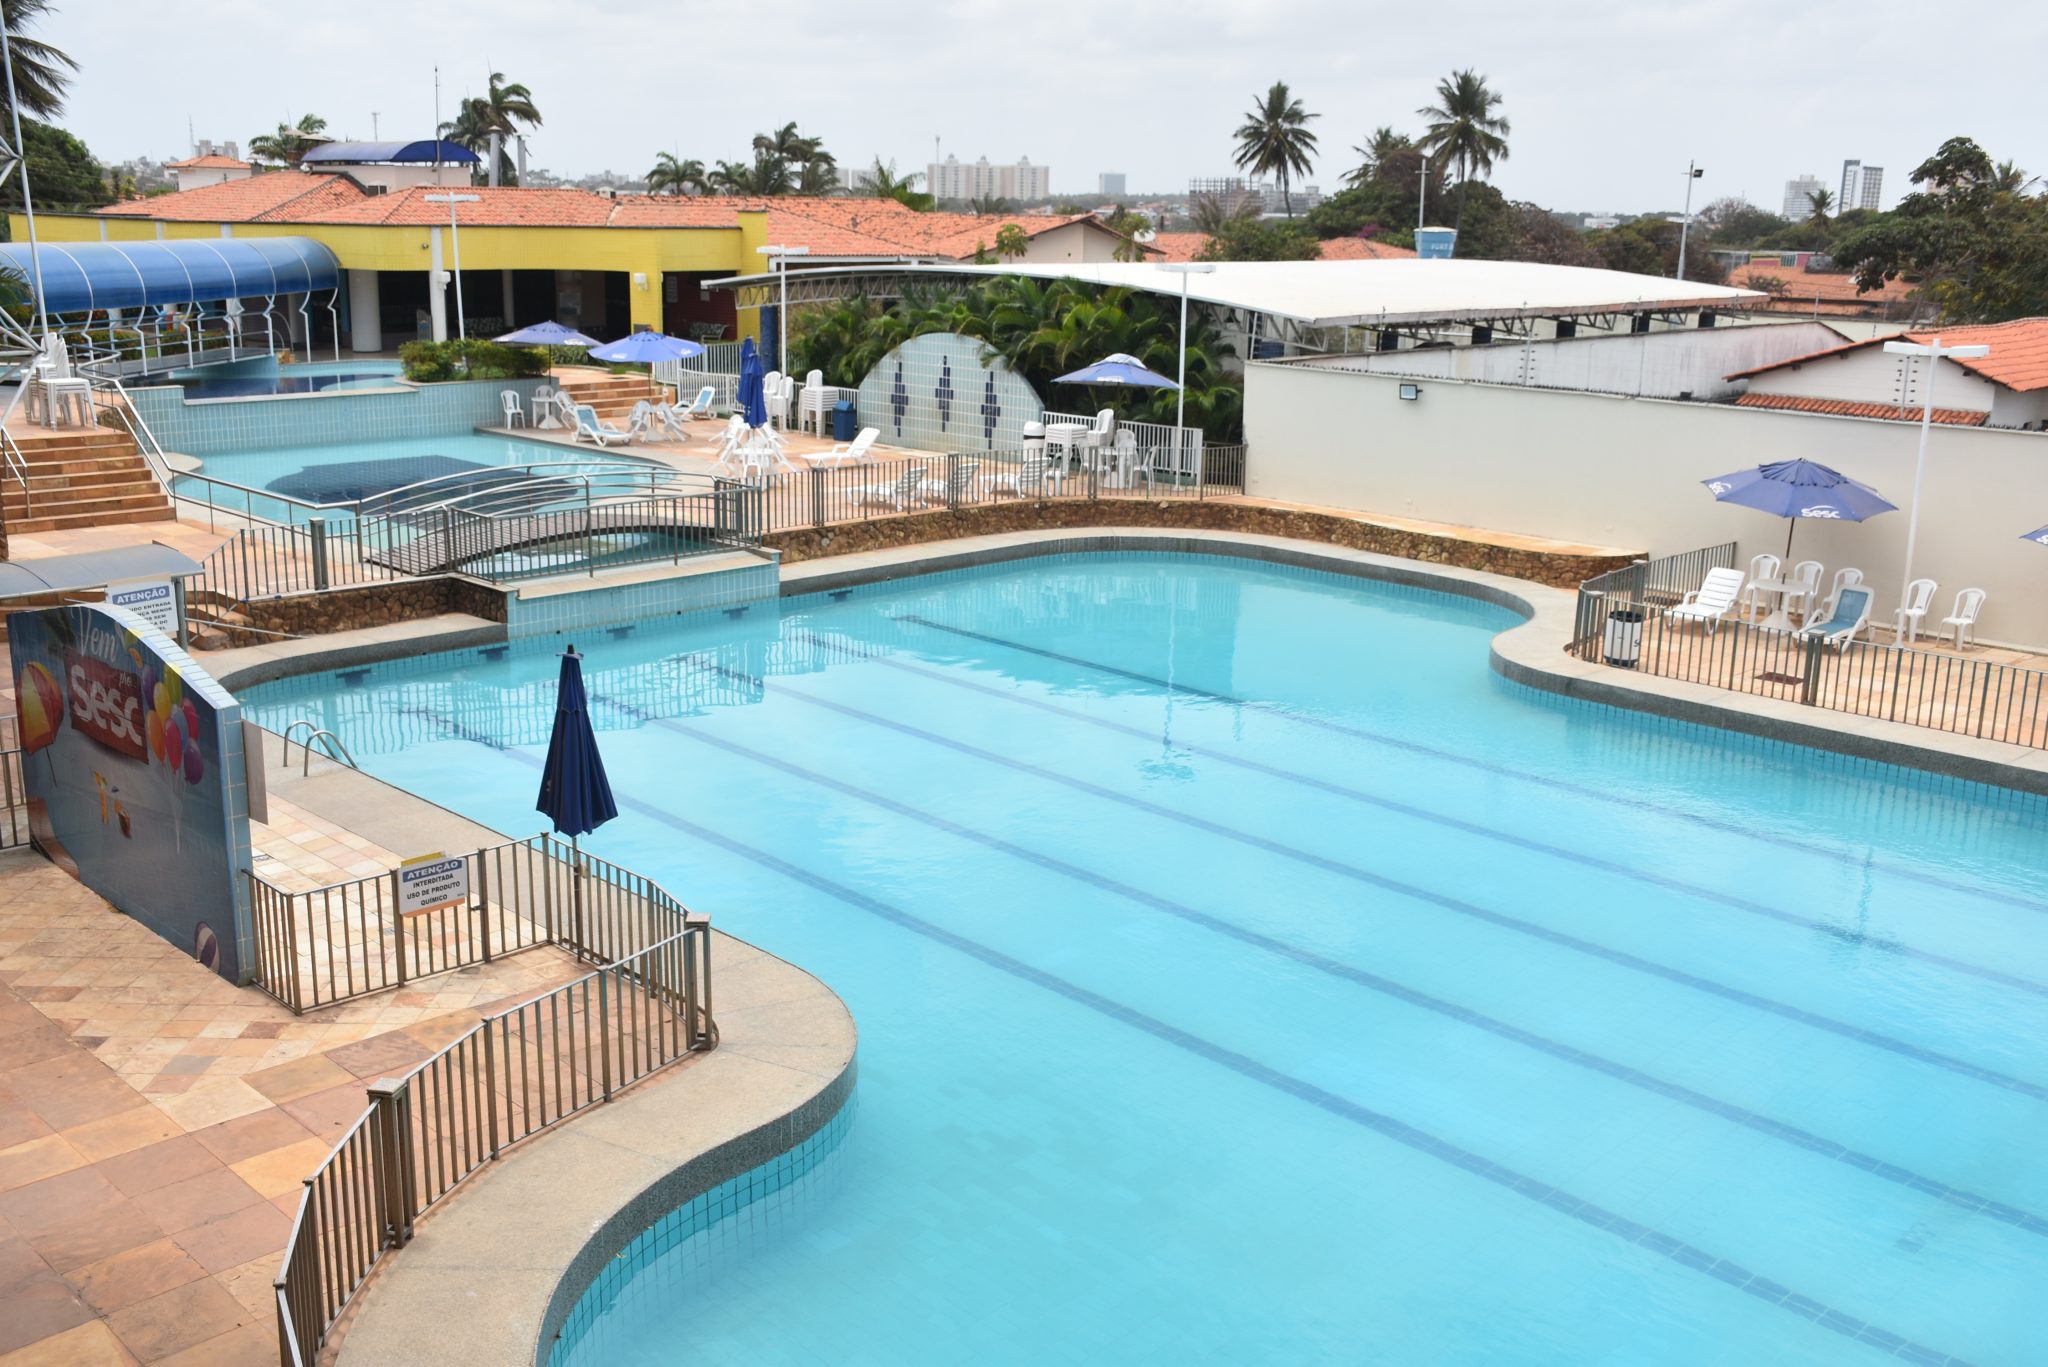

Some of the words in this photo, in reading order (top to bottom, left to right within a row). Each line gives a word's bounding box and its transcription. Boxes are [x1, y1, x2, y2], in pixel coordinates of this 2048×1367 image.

[117, 588, 166, 604] ATENÇÃO
[143, 601, 171, 609] ENTRADA
[70, 606, 118, 663] Vem
[71, 664, 142, 746] Sesc
[407, 861, 458, 880] ATENÇÃO
[413, 873, 453, 888] INTERDITADA
[407, 891, 420, 899] USO
[431, 881, 460, 893] PRODUTO
